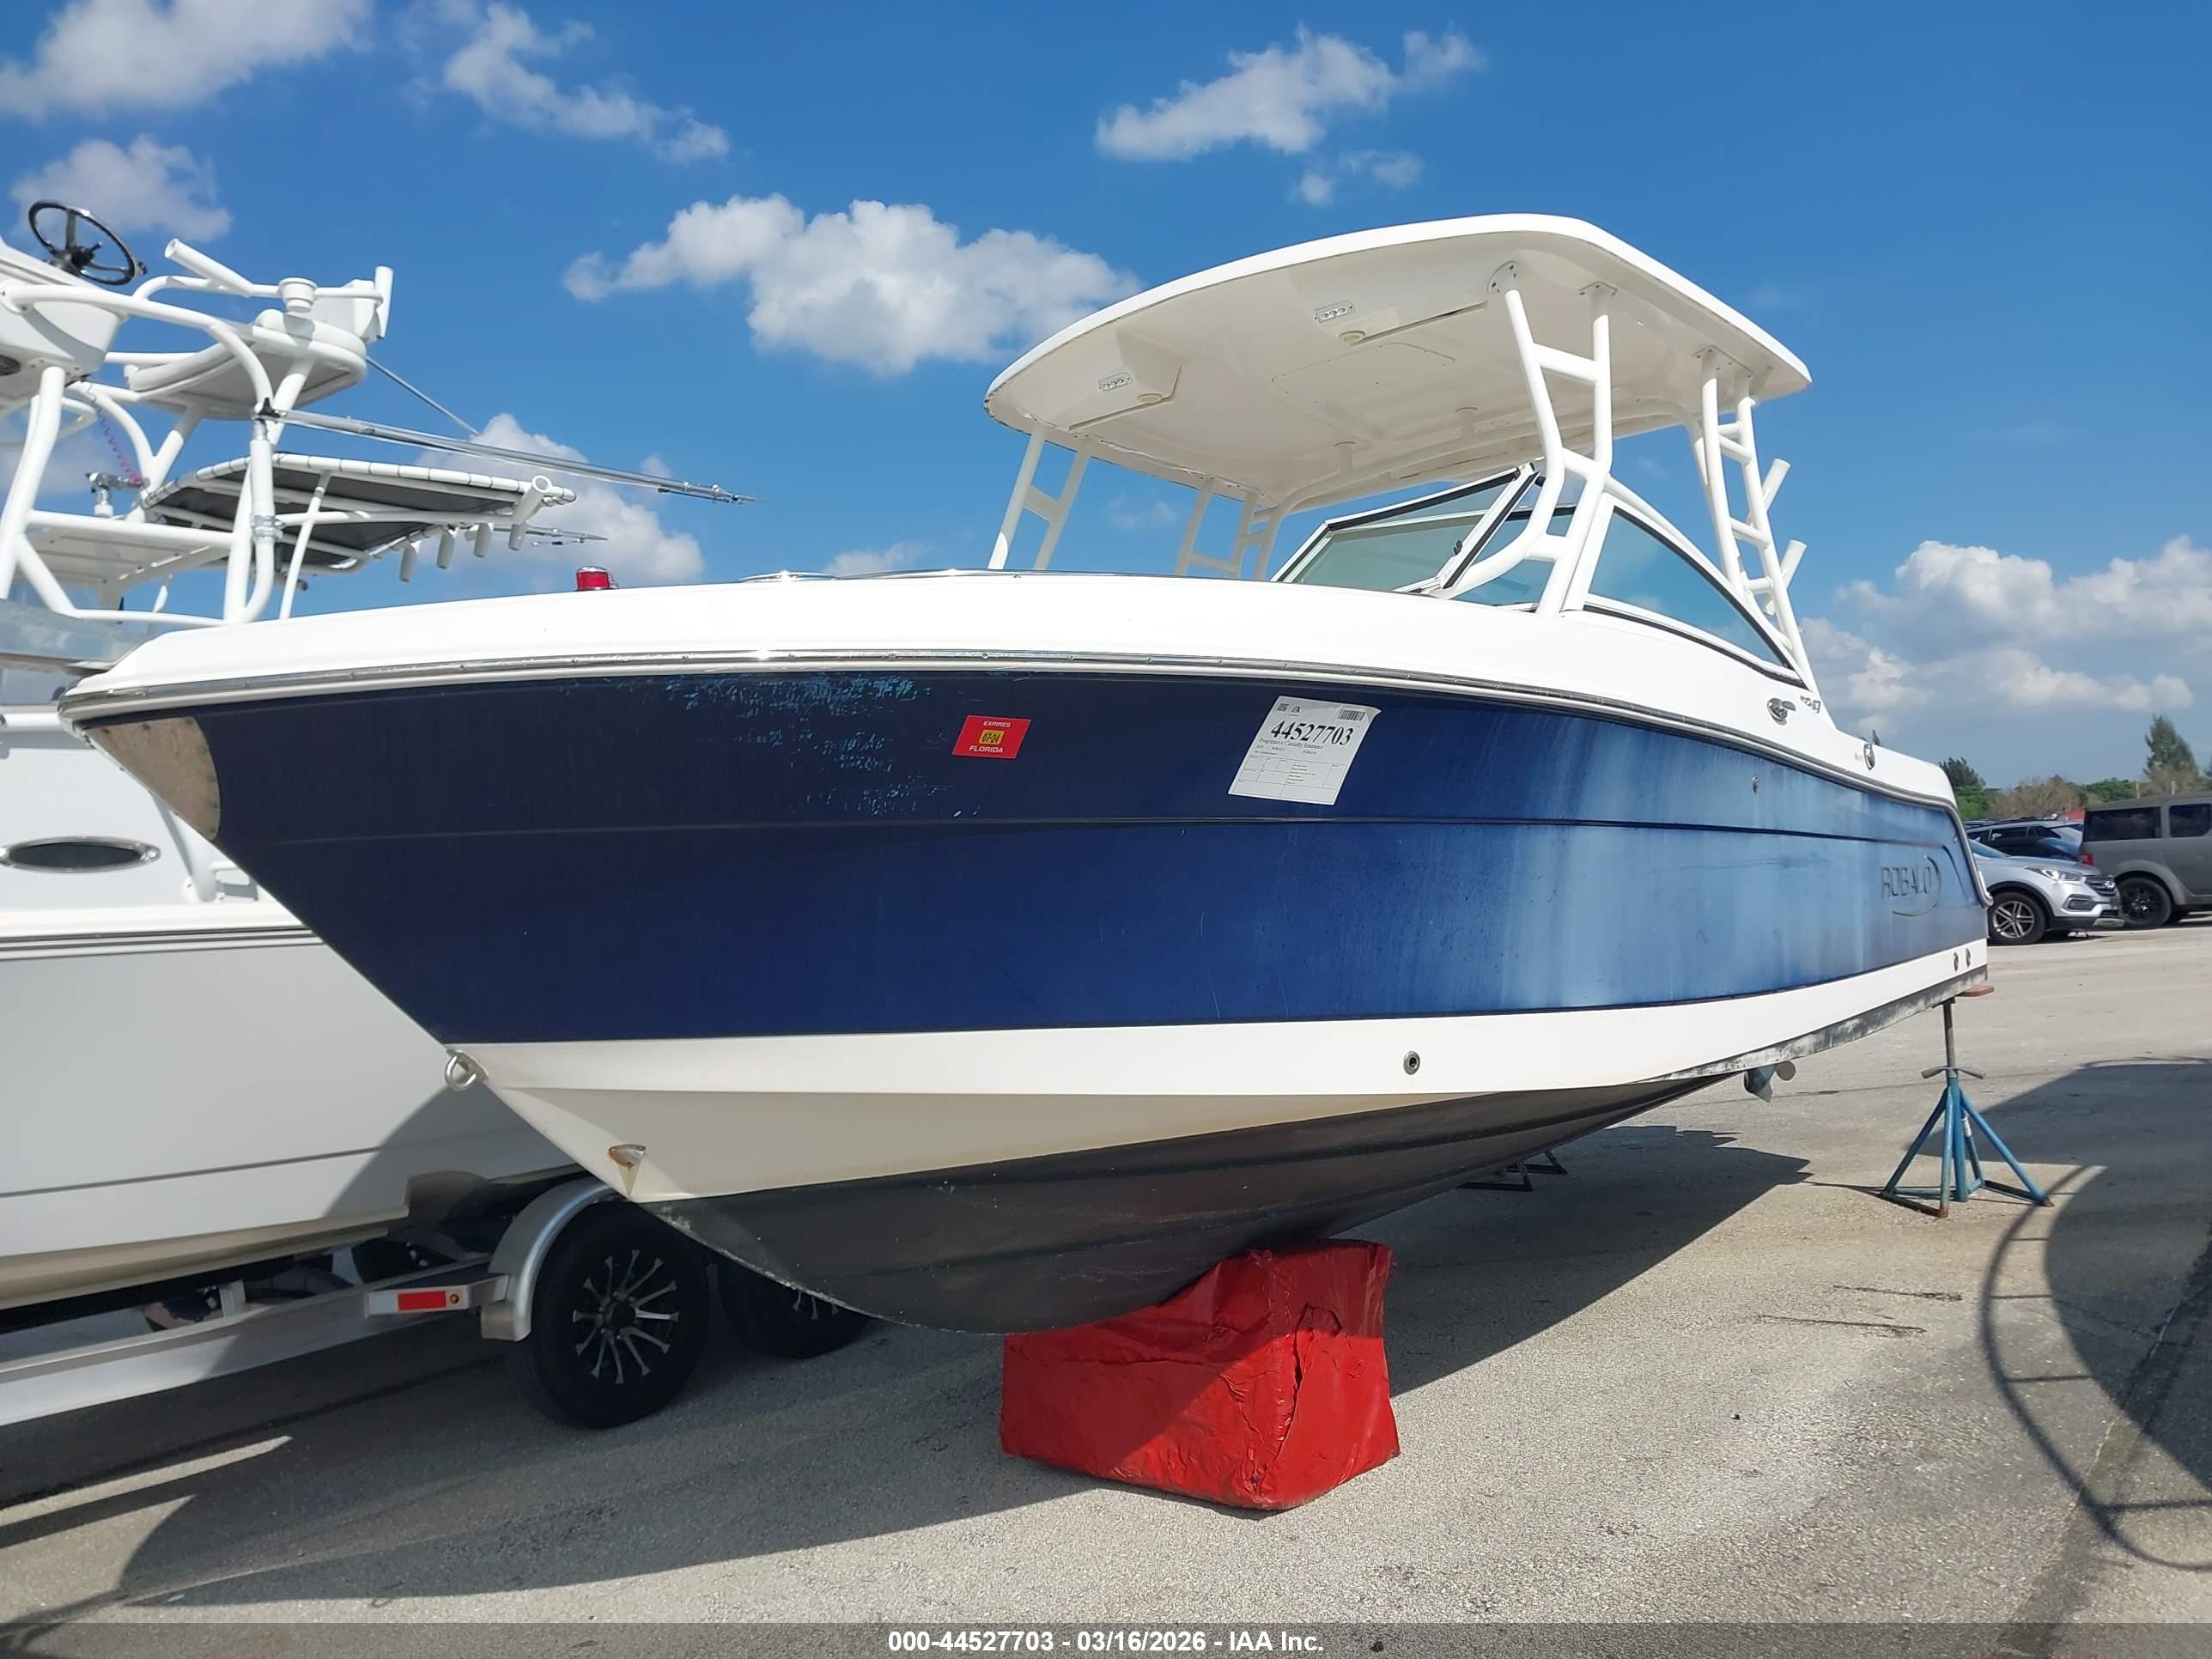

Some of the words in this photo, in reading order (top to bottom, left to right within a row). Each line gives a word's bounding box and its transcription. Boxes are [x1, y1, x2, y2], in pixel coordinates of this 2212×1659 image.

[1271, 720, 1353, 745] 44527703
[969, 744, 1004, 754] FLORIDA
[1258, 737, 1284, 745] Progressive
[1304, 742, 1324, 750] Insurance
